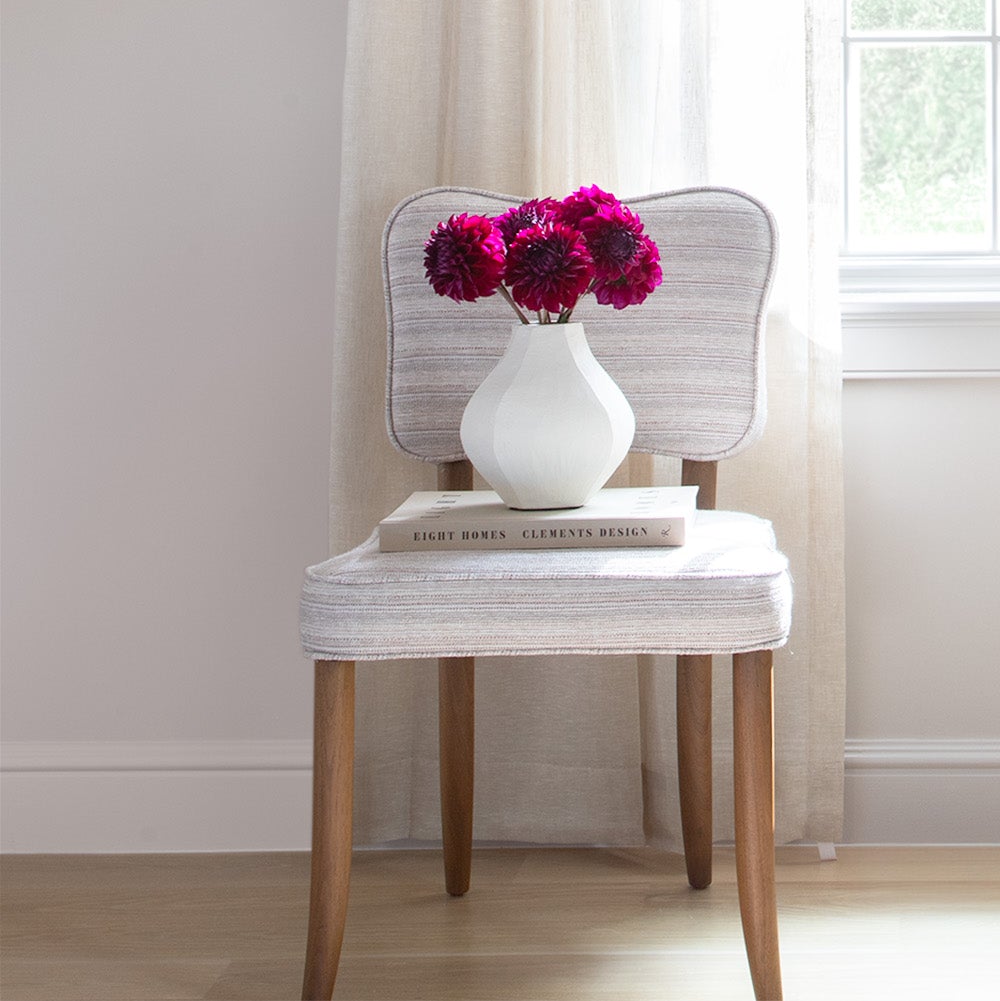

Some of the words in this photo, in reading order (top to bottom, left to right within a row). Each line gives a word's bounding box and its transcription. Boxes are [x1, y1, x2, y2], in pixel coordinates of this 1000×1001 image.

[413, 531, 455, 541] EIGHT
[461, 530, 507, 540] HOMES
[522, 527, 593, 539] CLEMENTS
[599, 526, 649, 537] DESIGN
